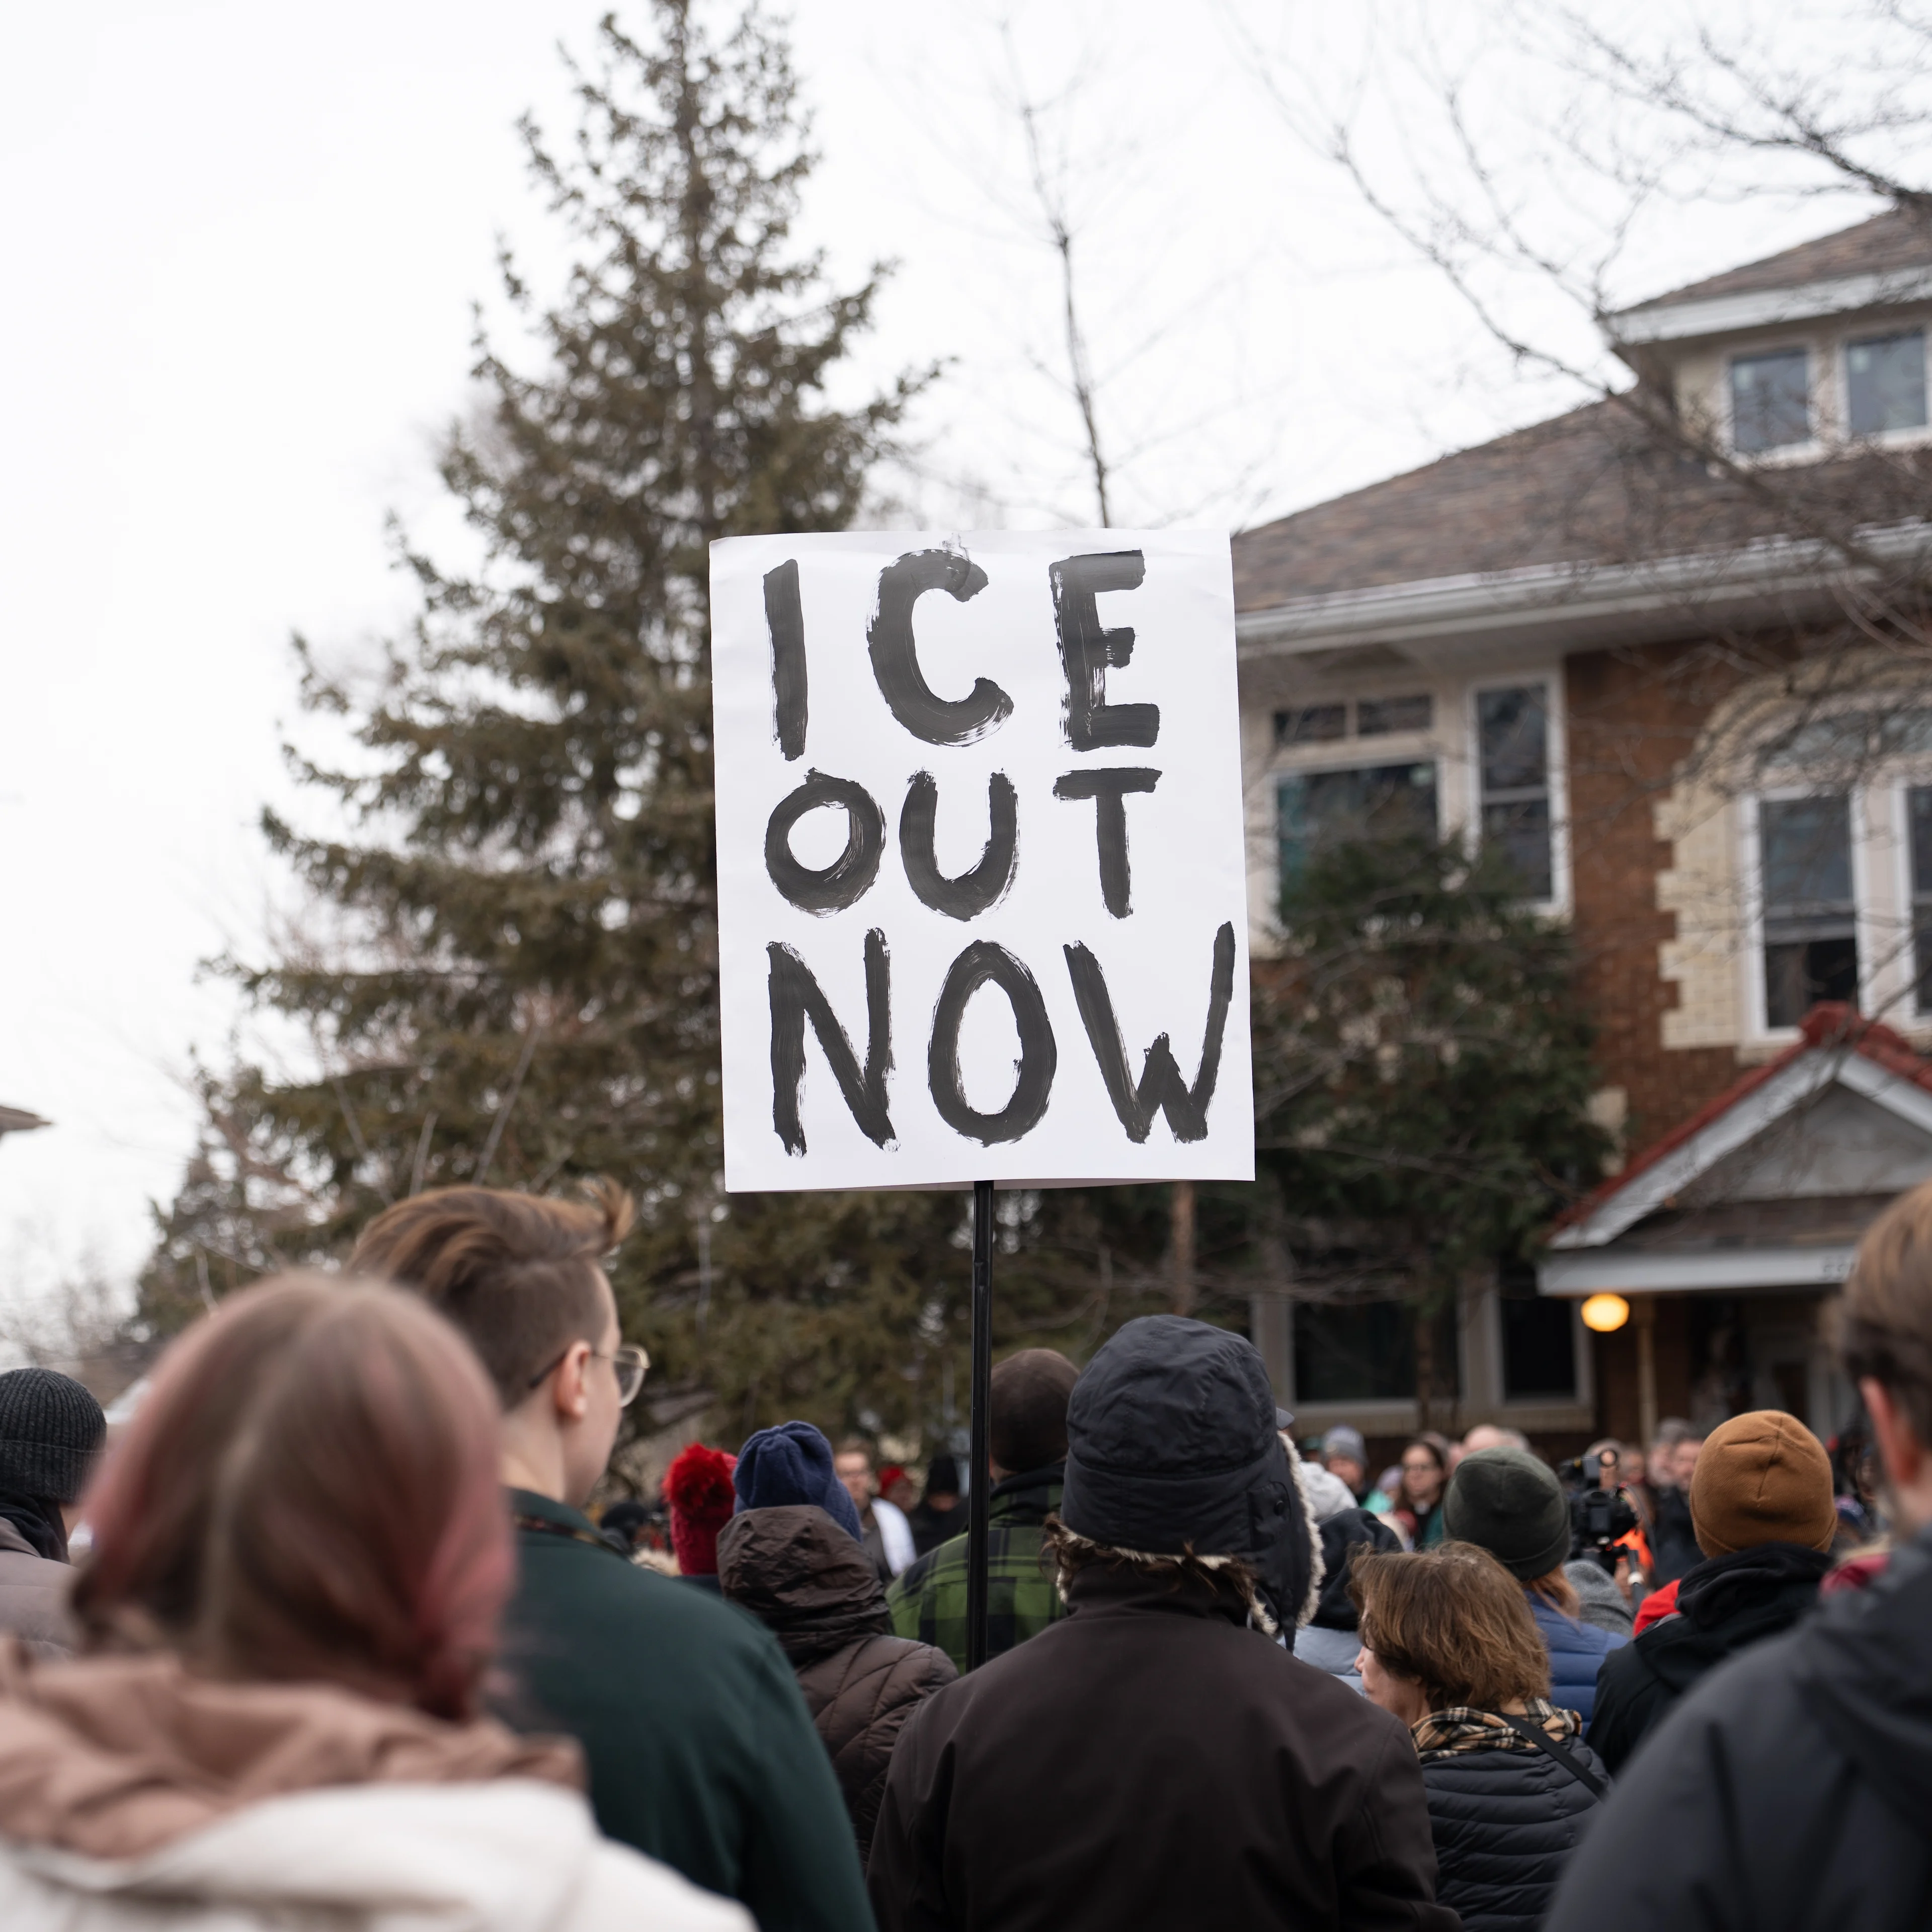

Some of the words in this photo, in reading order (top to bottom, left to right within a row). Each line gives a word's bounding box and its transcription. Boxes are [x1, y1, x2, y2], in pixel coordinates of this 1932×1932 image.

[763, 548, 1161, 761] ICE
[764, 767, 1163, 922] OUT
[766, 921, 1236, 1158] NOW
